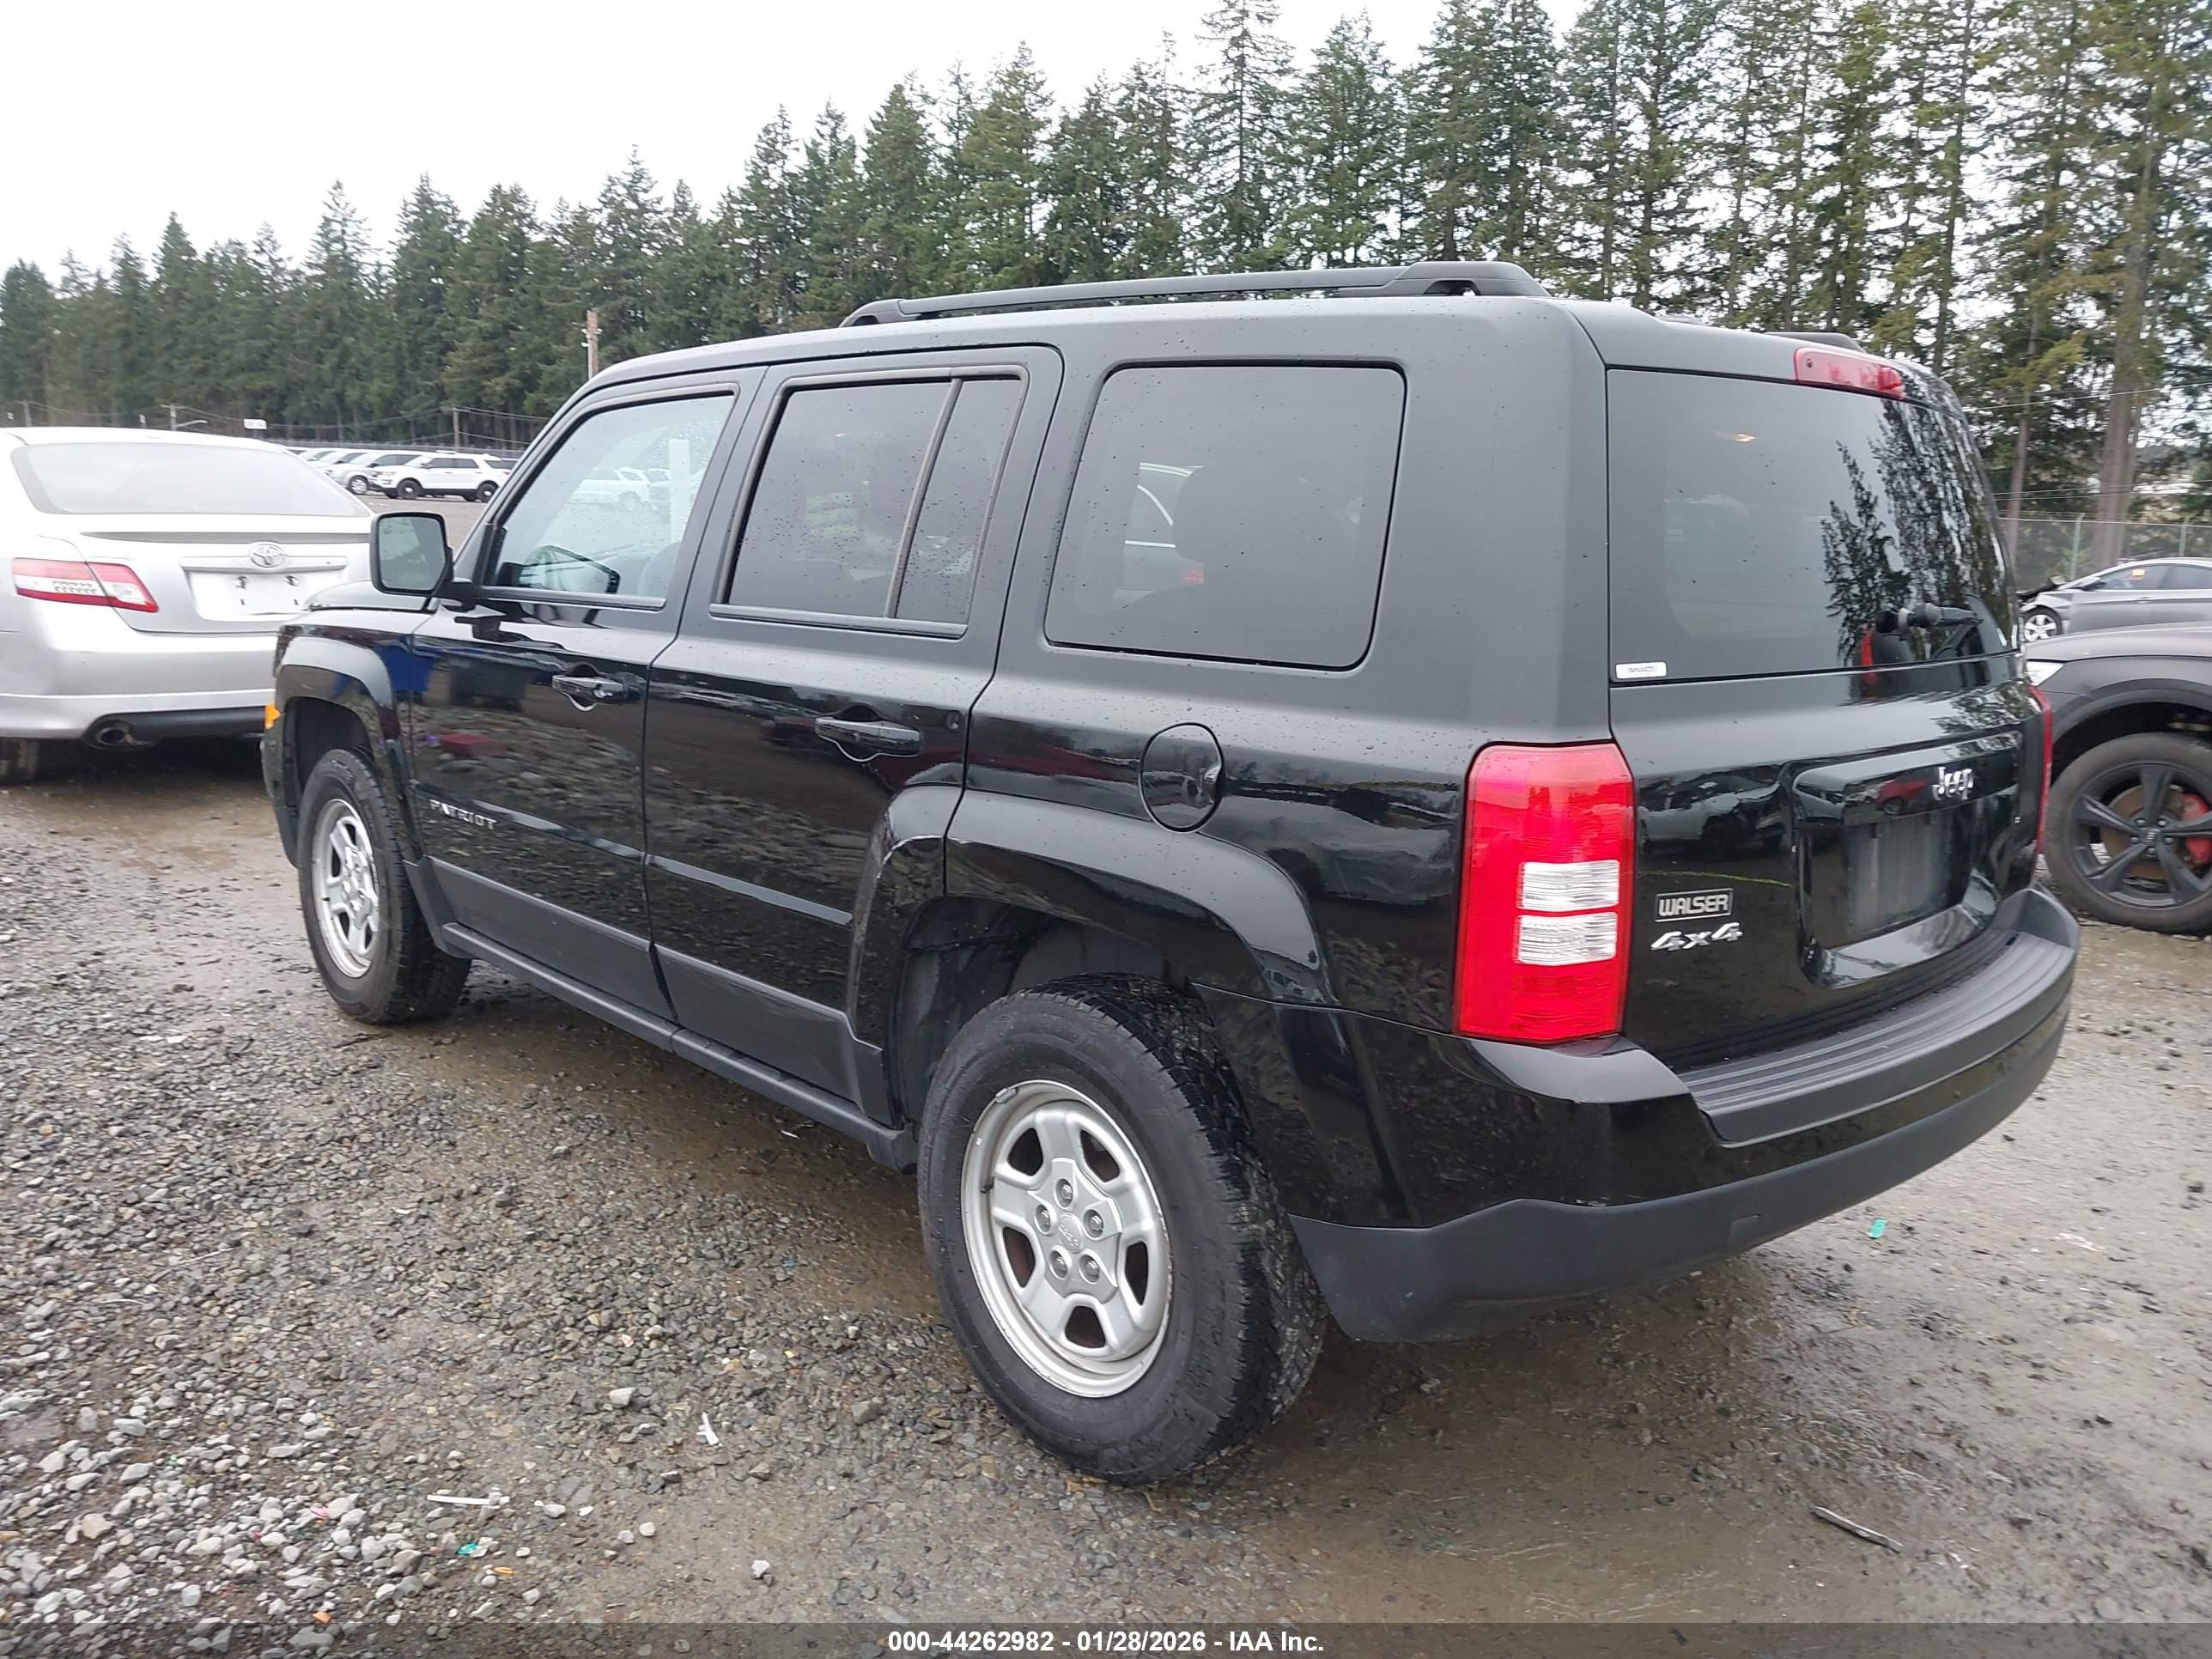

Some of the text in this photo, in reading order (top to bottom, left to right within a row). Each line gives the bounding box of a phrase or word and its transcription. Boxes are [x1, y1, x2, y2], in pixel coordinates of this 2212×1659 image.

[1931, 766, 1973, 801] Jeep
[429, 799, 497, 830] PATRIOT
[1658, 894, 1729, 917] WALSER
[1650, 921, 1744, 951] 4x4
